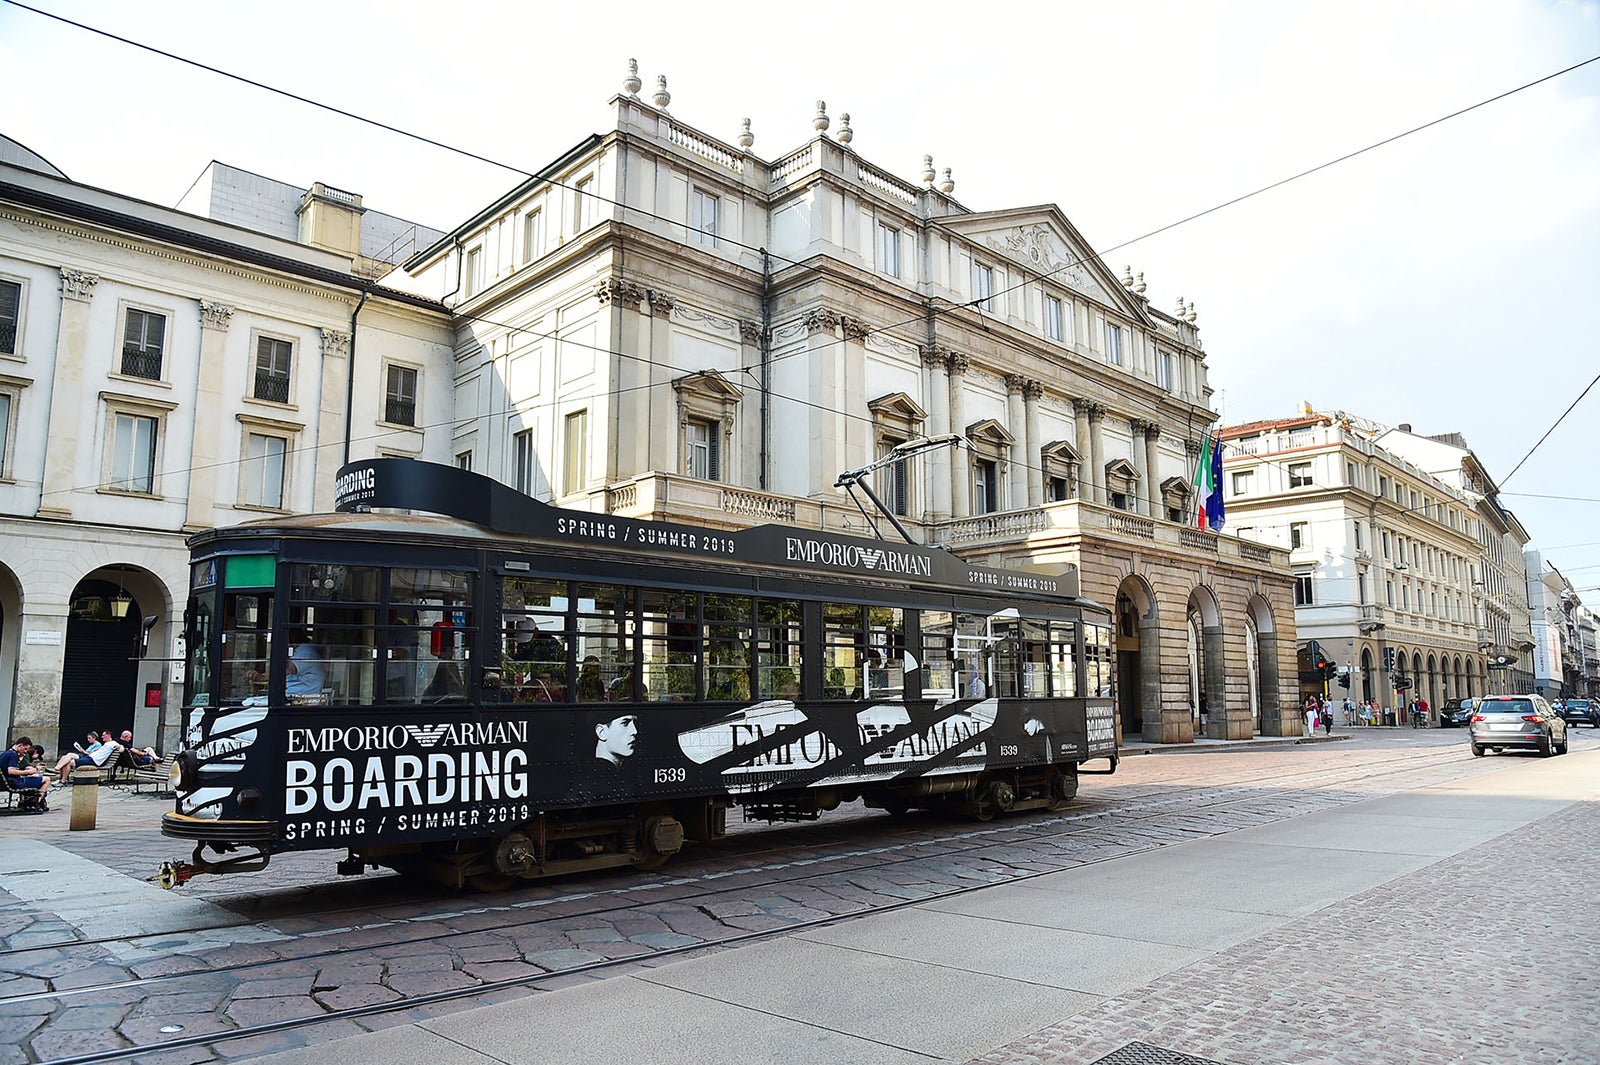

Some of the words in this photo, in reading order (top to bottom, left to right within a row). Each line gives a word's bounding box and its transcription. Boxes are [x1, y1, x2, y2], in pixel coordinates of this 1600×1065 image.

[558, 518, 616, 539] SPRING
[638, 528, 697, 549] SUMMER
[703, 536, 735, 553] 2019
[785, 537, 859, 568] EMPORIO
[877, 554, 932, 577] ARMANI
[968, 571, 998, 585] SPRING
[1007, 575, 1038, 590] SUMMER
[1039, 579, 1058, 592] 2019
[287, 725, 409, 753] EMPORIO
[442, 721, 529, 747] ARMANI
[1000, 745, 1018, 757] 1539
[286, 749, 528, 815] BOARDING
[654, 768, 686, 783] 1539
[286, 818, 366, 840] SPRING
[398, 810, 480, 831] SUMMER
[488, 804, 529, 824] 2019
